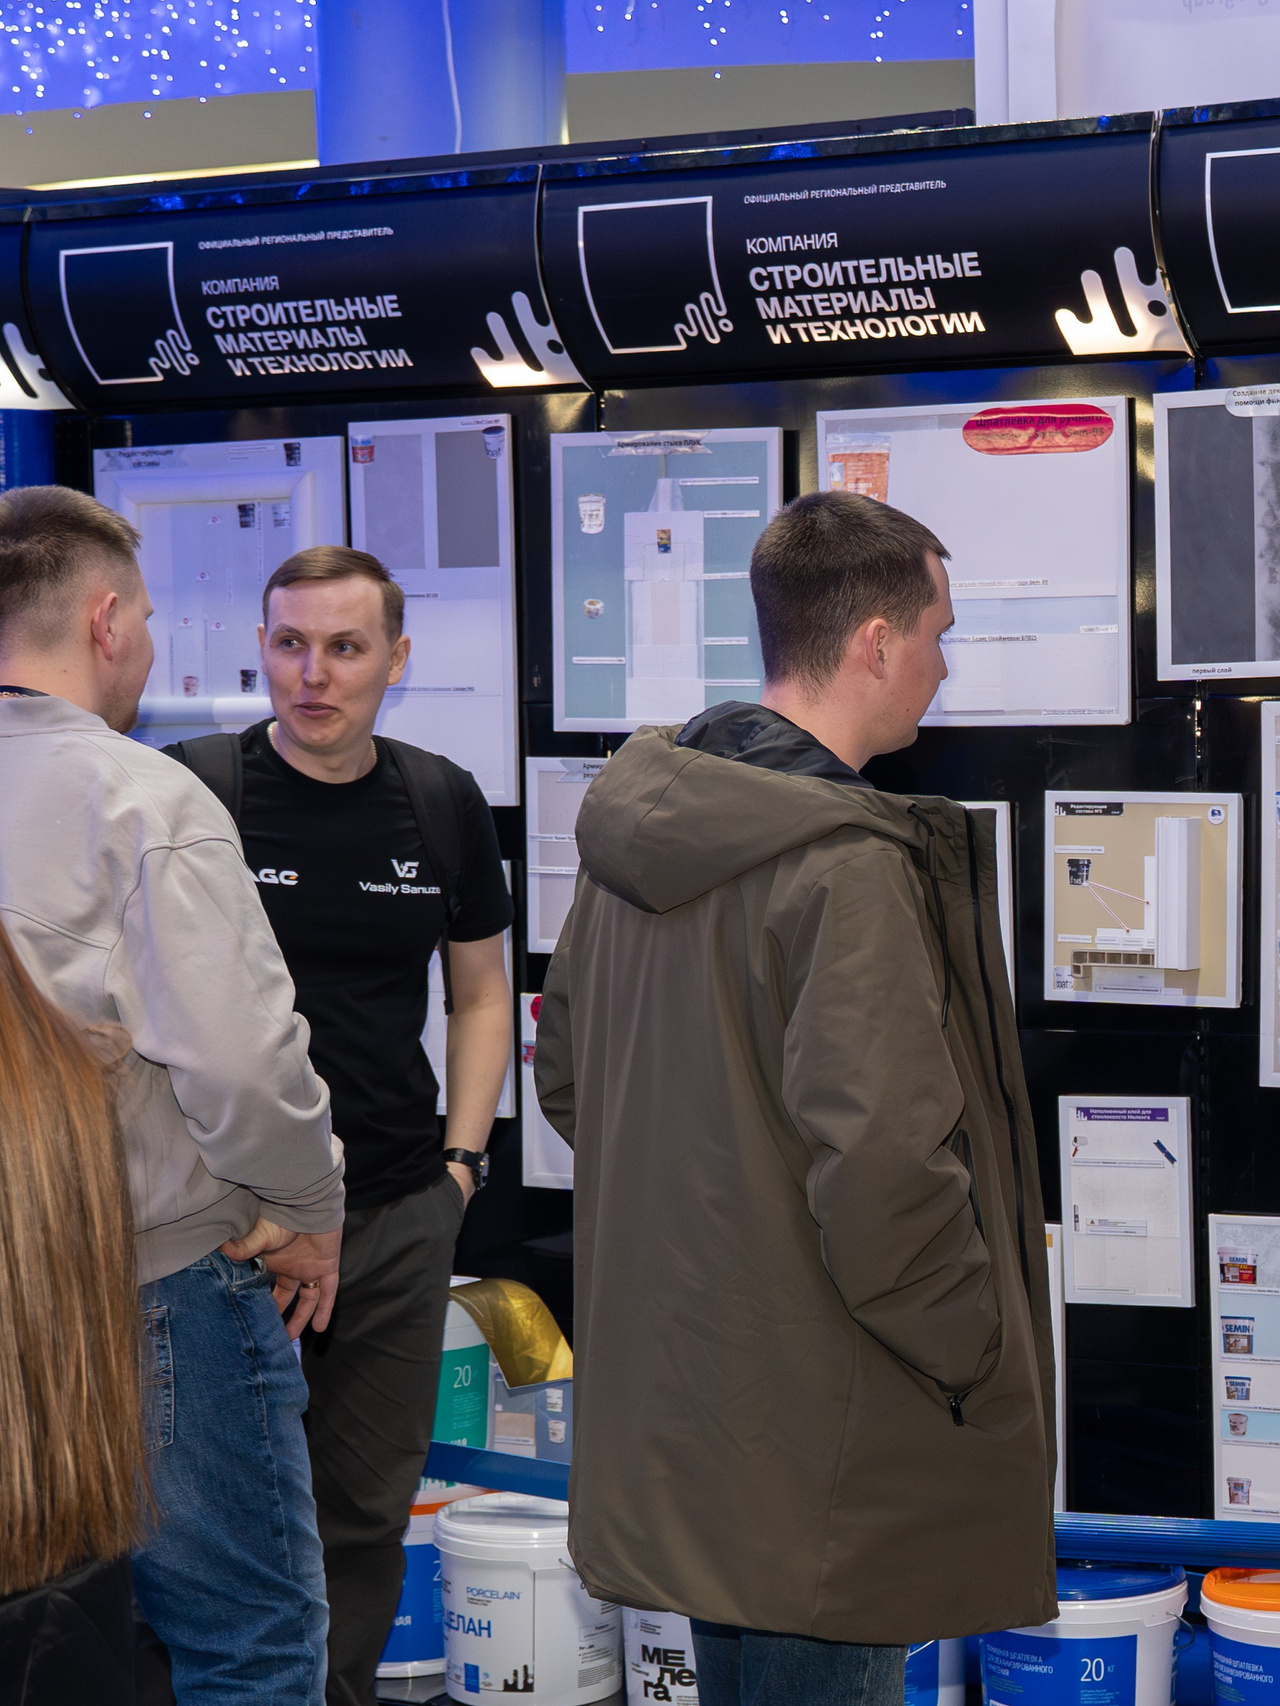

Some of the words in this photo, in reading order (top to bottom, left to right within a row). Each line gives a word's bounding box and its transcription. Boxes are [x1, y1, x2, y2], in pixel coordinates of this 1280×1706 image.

[744, 190, 809, 204] ОФИЦИАЛЬНЫЙ
[810, 184, 877, 199] РЕГИОНАЛЬНЫЙ
[879, 180, 947, 193] ПРЕДСТАВИТЕЛЬ
[326, 227, 394, 240] ПРЕДСТАВИТЕЛЬ
[746, 232, 838, 254] КОМПАНИЯ
[749, 252, 982, 291] СТРОИТЕЛЬНЫЕ
[201, 275, 279, 295] КОМПАНИЯ
[206, 295, 402, 329] СТРОИТЕЛЬНЫЕ
[756, 287, 936, 319] МАТЕРИАЛЫ
[766, 324, 792, 344] И
[790, 311, 986, 343] ТЕХНОЛОГИИ
[214, 326, 368, 354] МАТЕРИАЛЫ
[227, 358, 251, 377] И
[249, 348, 414, 375] ТЕХНОЛОГИИ
[1192, 667, 1216, 675] первый
[359, 881, 399, 895] Vasily
[1229, 1256, 1248, 1264] SEMIN
[1224, 1324, 1250, 1333] SEMIN
[453, 1365, 471, 1389] 20
[466, 1587, 520, 1600] PORCELAIN
[641, 1644, 685, 1667] МЕ
[1080, 1658, 1104, 1681] 20
